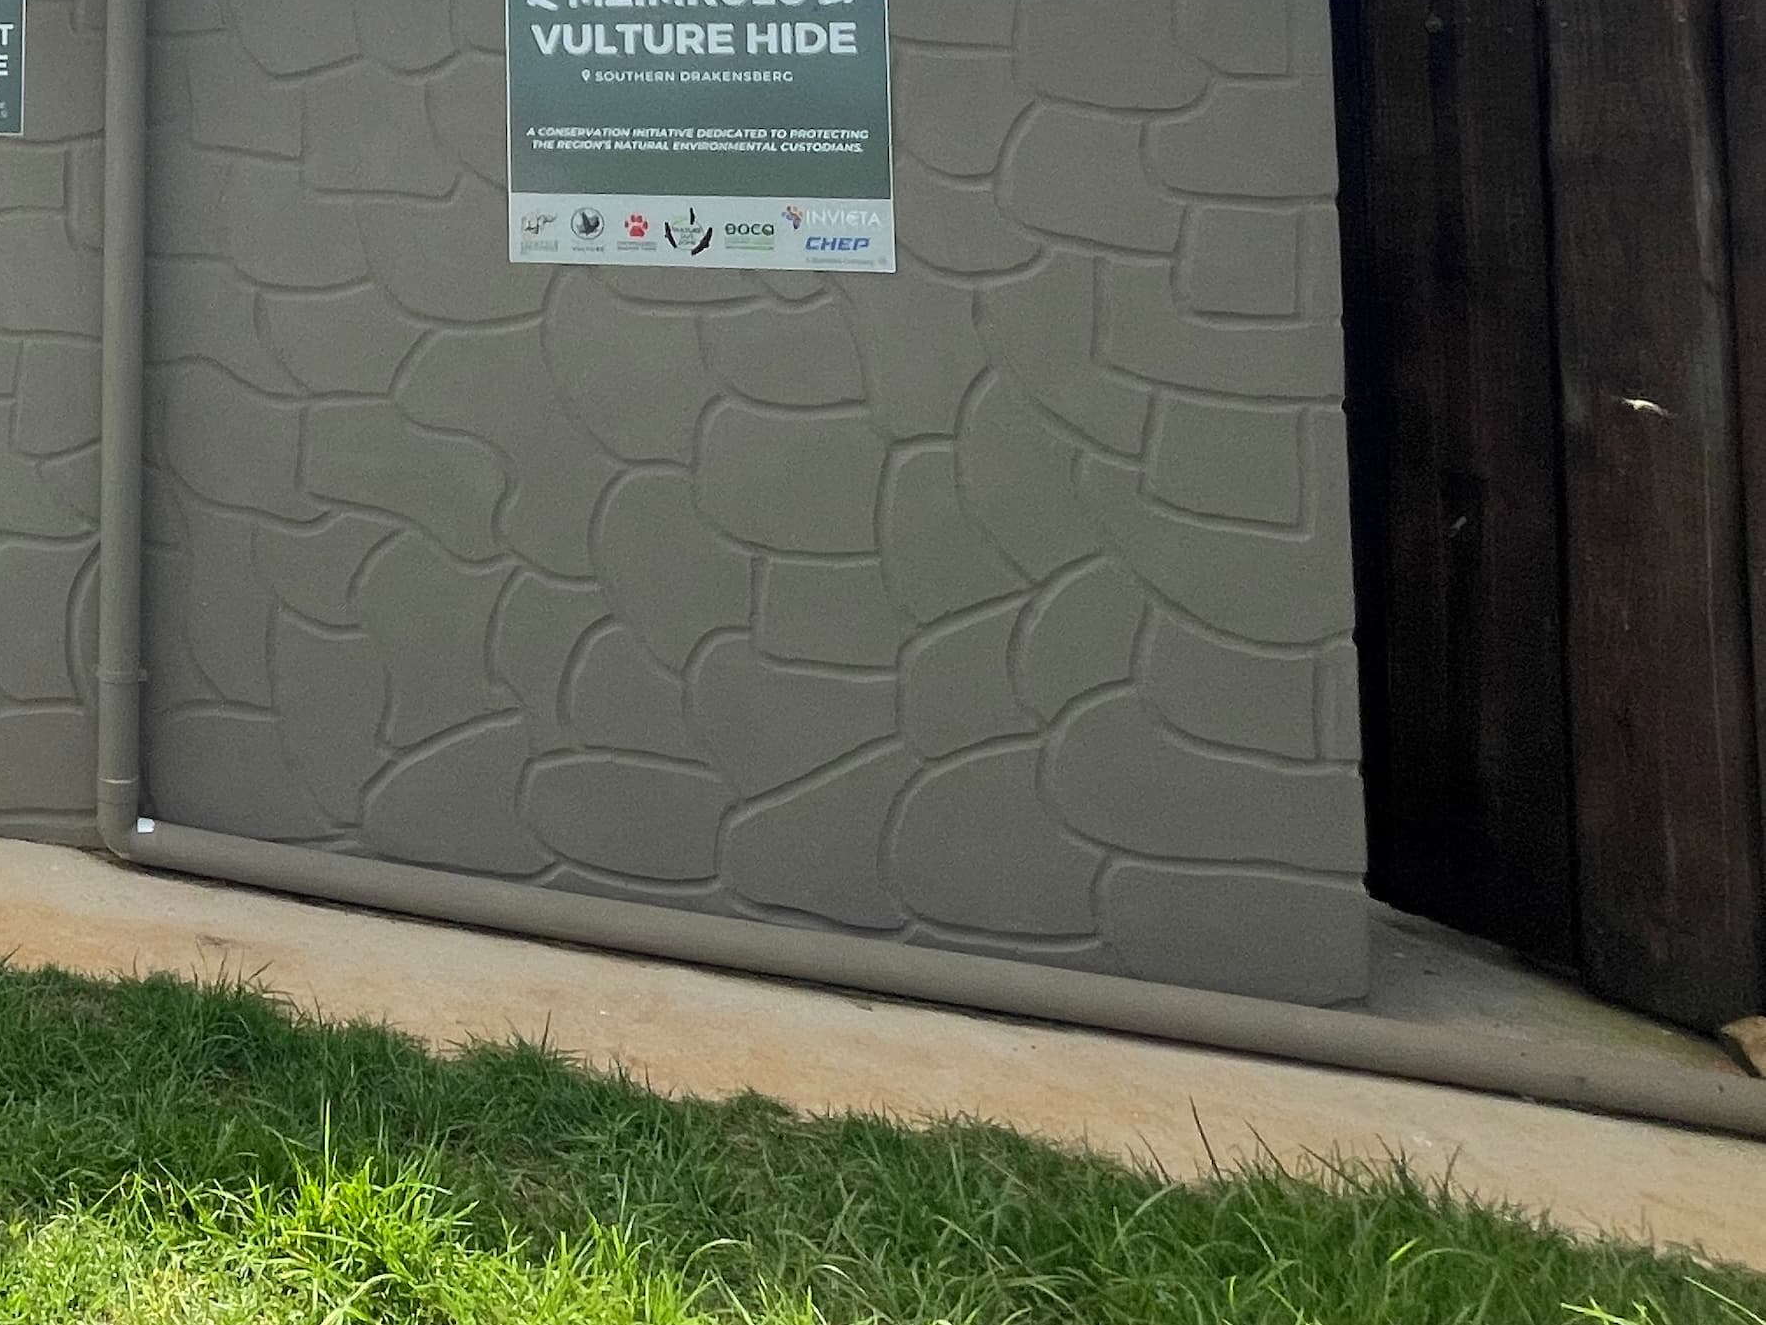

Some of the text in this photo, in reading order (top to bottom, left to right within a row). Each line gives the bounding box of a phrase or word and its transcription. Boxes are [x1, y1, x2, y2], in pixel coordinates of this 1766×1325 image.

[531, 21, 859, 56] VULTURE HIDE
[595, 70, 794, 83] SOUTHERN DRAKENSBERG
[526, 127, 869, 140] A CONSERVATION INITIATIVE DEDICATED TO PROTECTING
[532, 140, 554, 150] THE
[556, 140, 612, 150] REGION'S
[614, 141, 669, 150] NATURAL
[672, 141, 777, 152] ENVIRONMENTAL
[806, 210, 882, 227] INVICTA
[806, 236, 870, 251] CHEP
